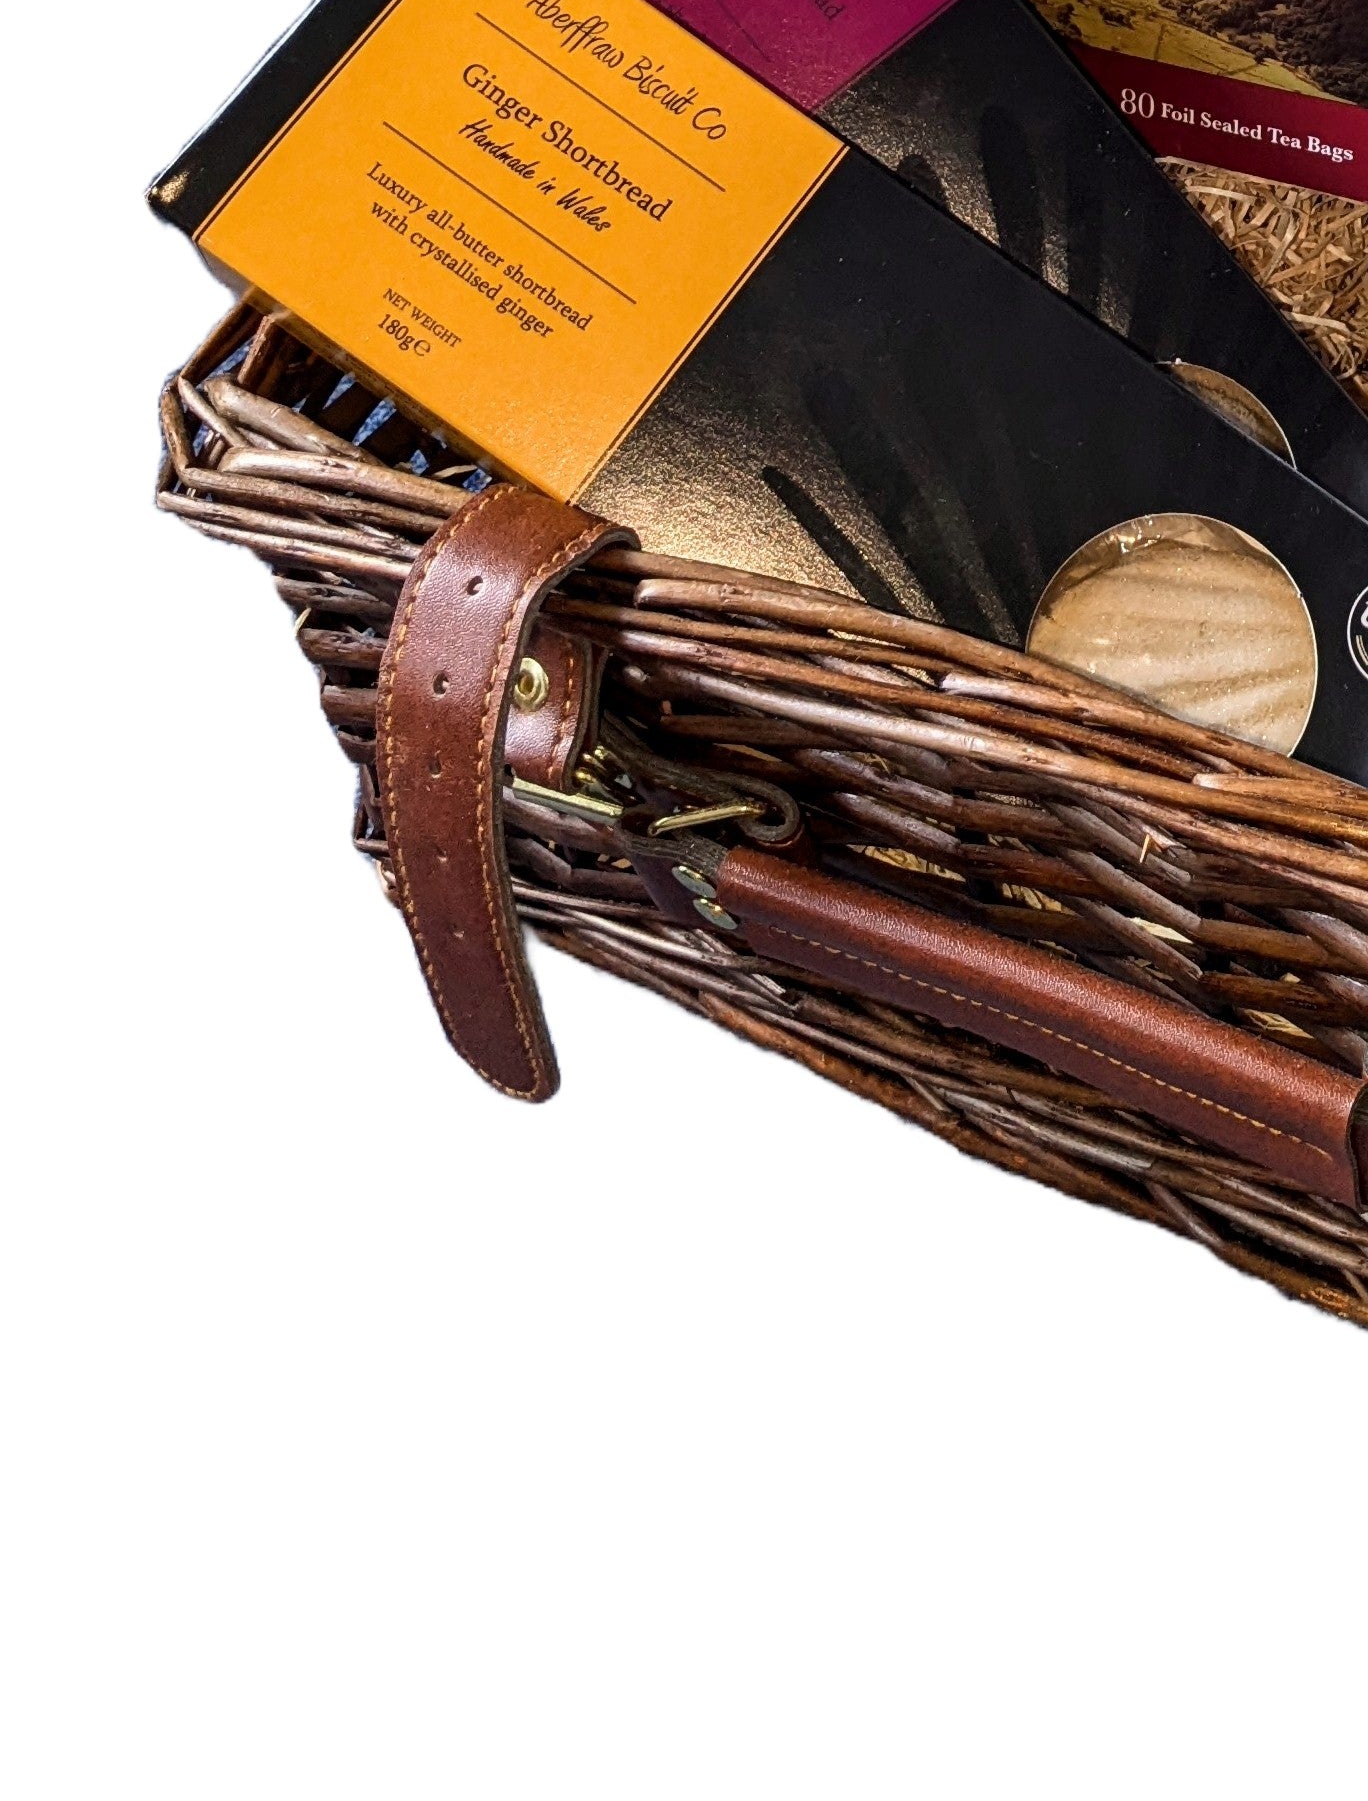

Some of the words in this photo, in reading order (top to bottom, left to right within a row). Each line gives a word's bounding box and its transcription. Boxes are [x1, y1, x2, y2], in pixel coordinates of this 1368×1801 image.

[463, 63, 543, 129] Ginger
[541, 120, 673, 222] Shortbread
[623, 55, 699, 115] Biscuit
[692, 107, 727, 140] Co
[1120, 88, 1155, 119] 80
[1160, 102, 1195, 125] Foil
[1200, 111, 1262, 140] Sealed
[1267, 127, 1302, 150] Tea
[1306, 135, 1354, 163] Bags
[458, 118, 541, 179] Handmade
[536, 177, 556, 195] in
[556, 188, 611, 232] Wales
[367, 161, 428, 214] Luxury
[427, 207, 505, 268] all-butter
[503, 264, 594, 331] shortbread
[371, 201, 409, 236] with
[410, 230, 503, 301] crystallised
[496, 295, 554, 339] ginger
[383, 288, 412, 313] NET
[411, 309, 462, 349] WEIGHT
